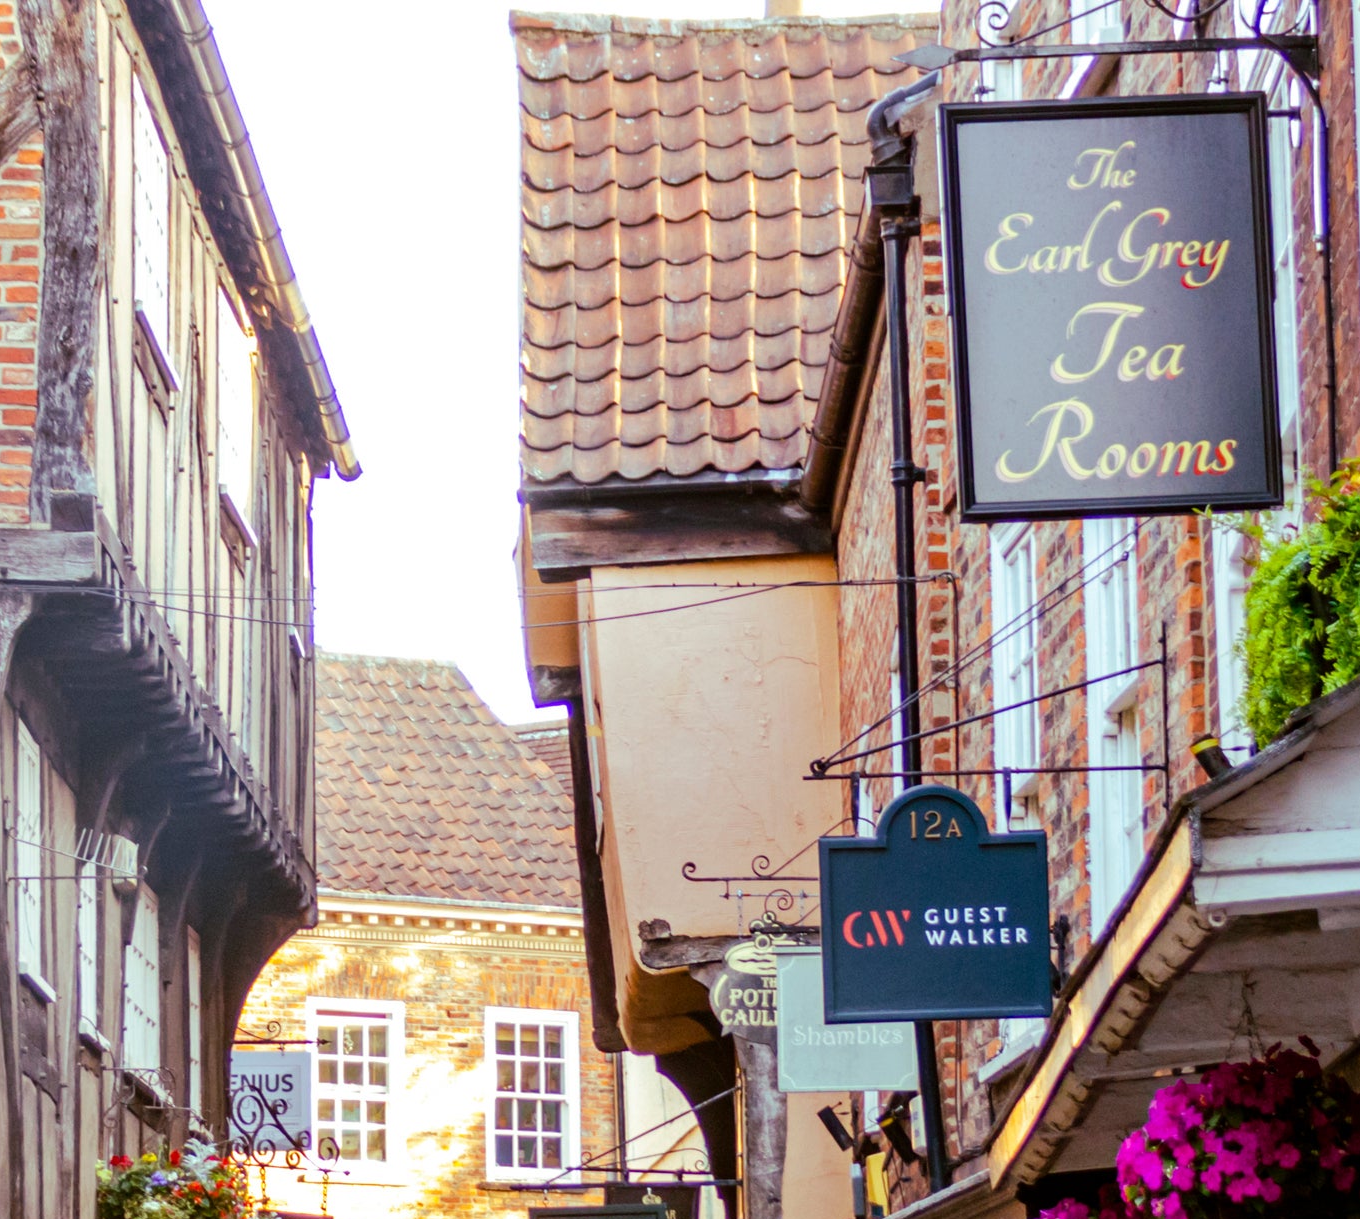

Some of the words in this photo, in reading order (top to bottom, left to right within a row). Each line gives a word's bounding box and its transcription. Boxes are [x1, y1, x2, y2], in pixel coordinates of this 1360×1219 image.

[1067, 140, 1137, 190] The
[984, 200, 1122, 275] Earl
[1097, 207, 1231, 289] Grey
[1050, 301, 1187, 384] Tea
[995, 396, 1238, 483] Rooms
[909, 810, 964, 839] 12A
[923, 906, 1008, 924] GUEST
[924, 927, 1029, 946] WALKER
[720, 1008, 777, 1027] CAUL
[790, 1025, 904, 1047] Shambles
